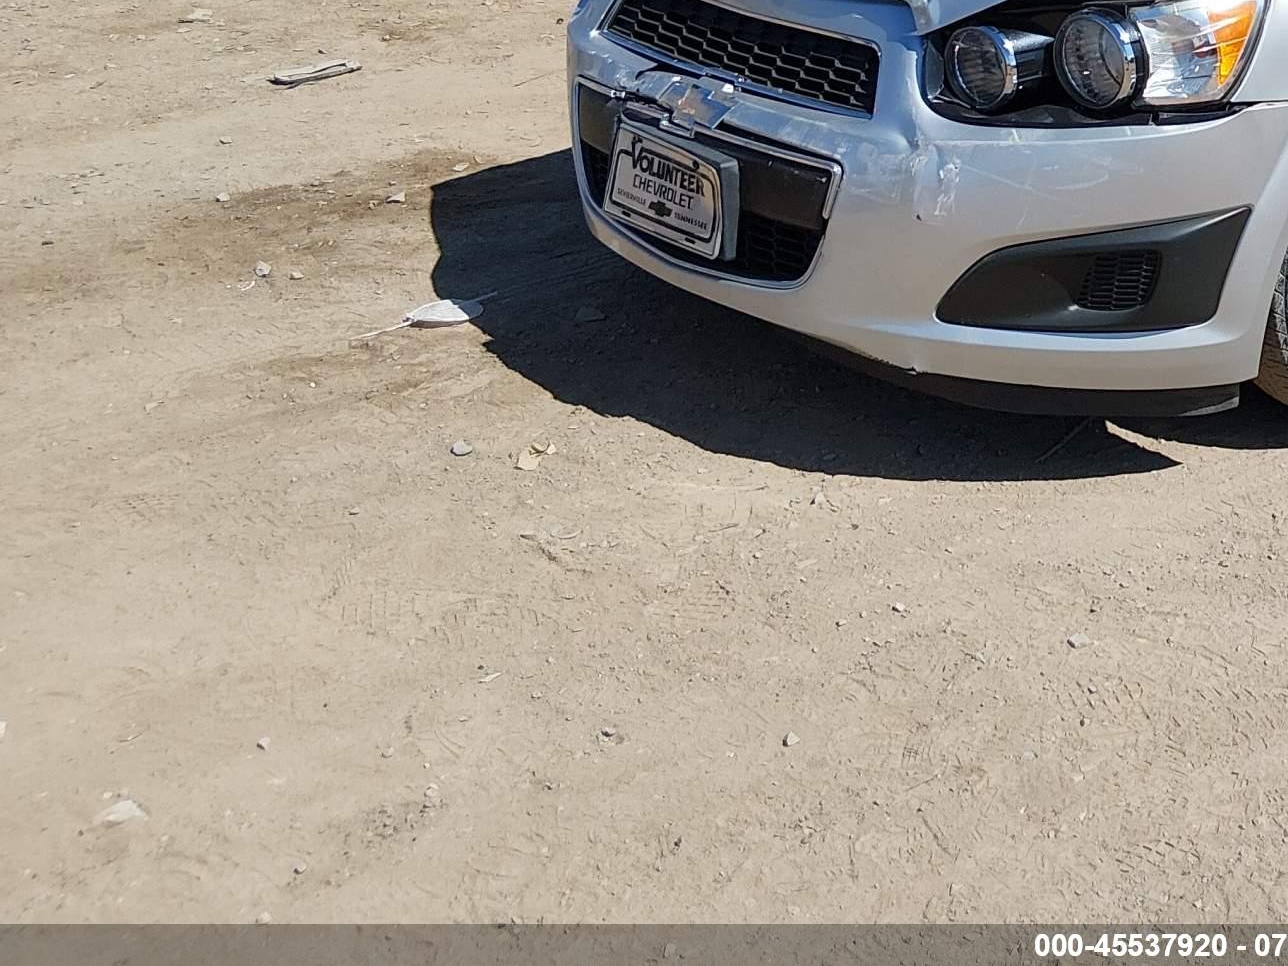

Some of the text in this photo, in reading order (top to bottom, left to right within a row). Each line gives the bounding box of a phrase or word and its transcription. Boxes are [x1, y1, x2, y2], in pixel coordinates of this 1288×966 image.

[632, 135, 706, 197] VOLUNTEER
[633, 174, 695, 211] CHEVROLET
[674, 212, 708, 231] TENNESSEE
